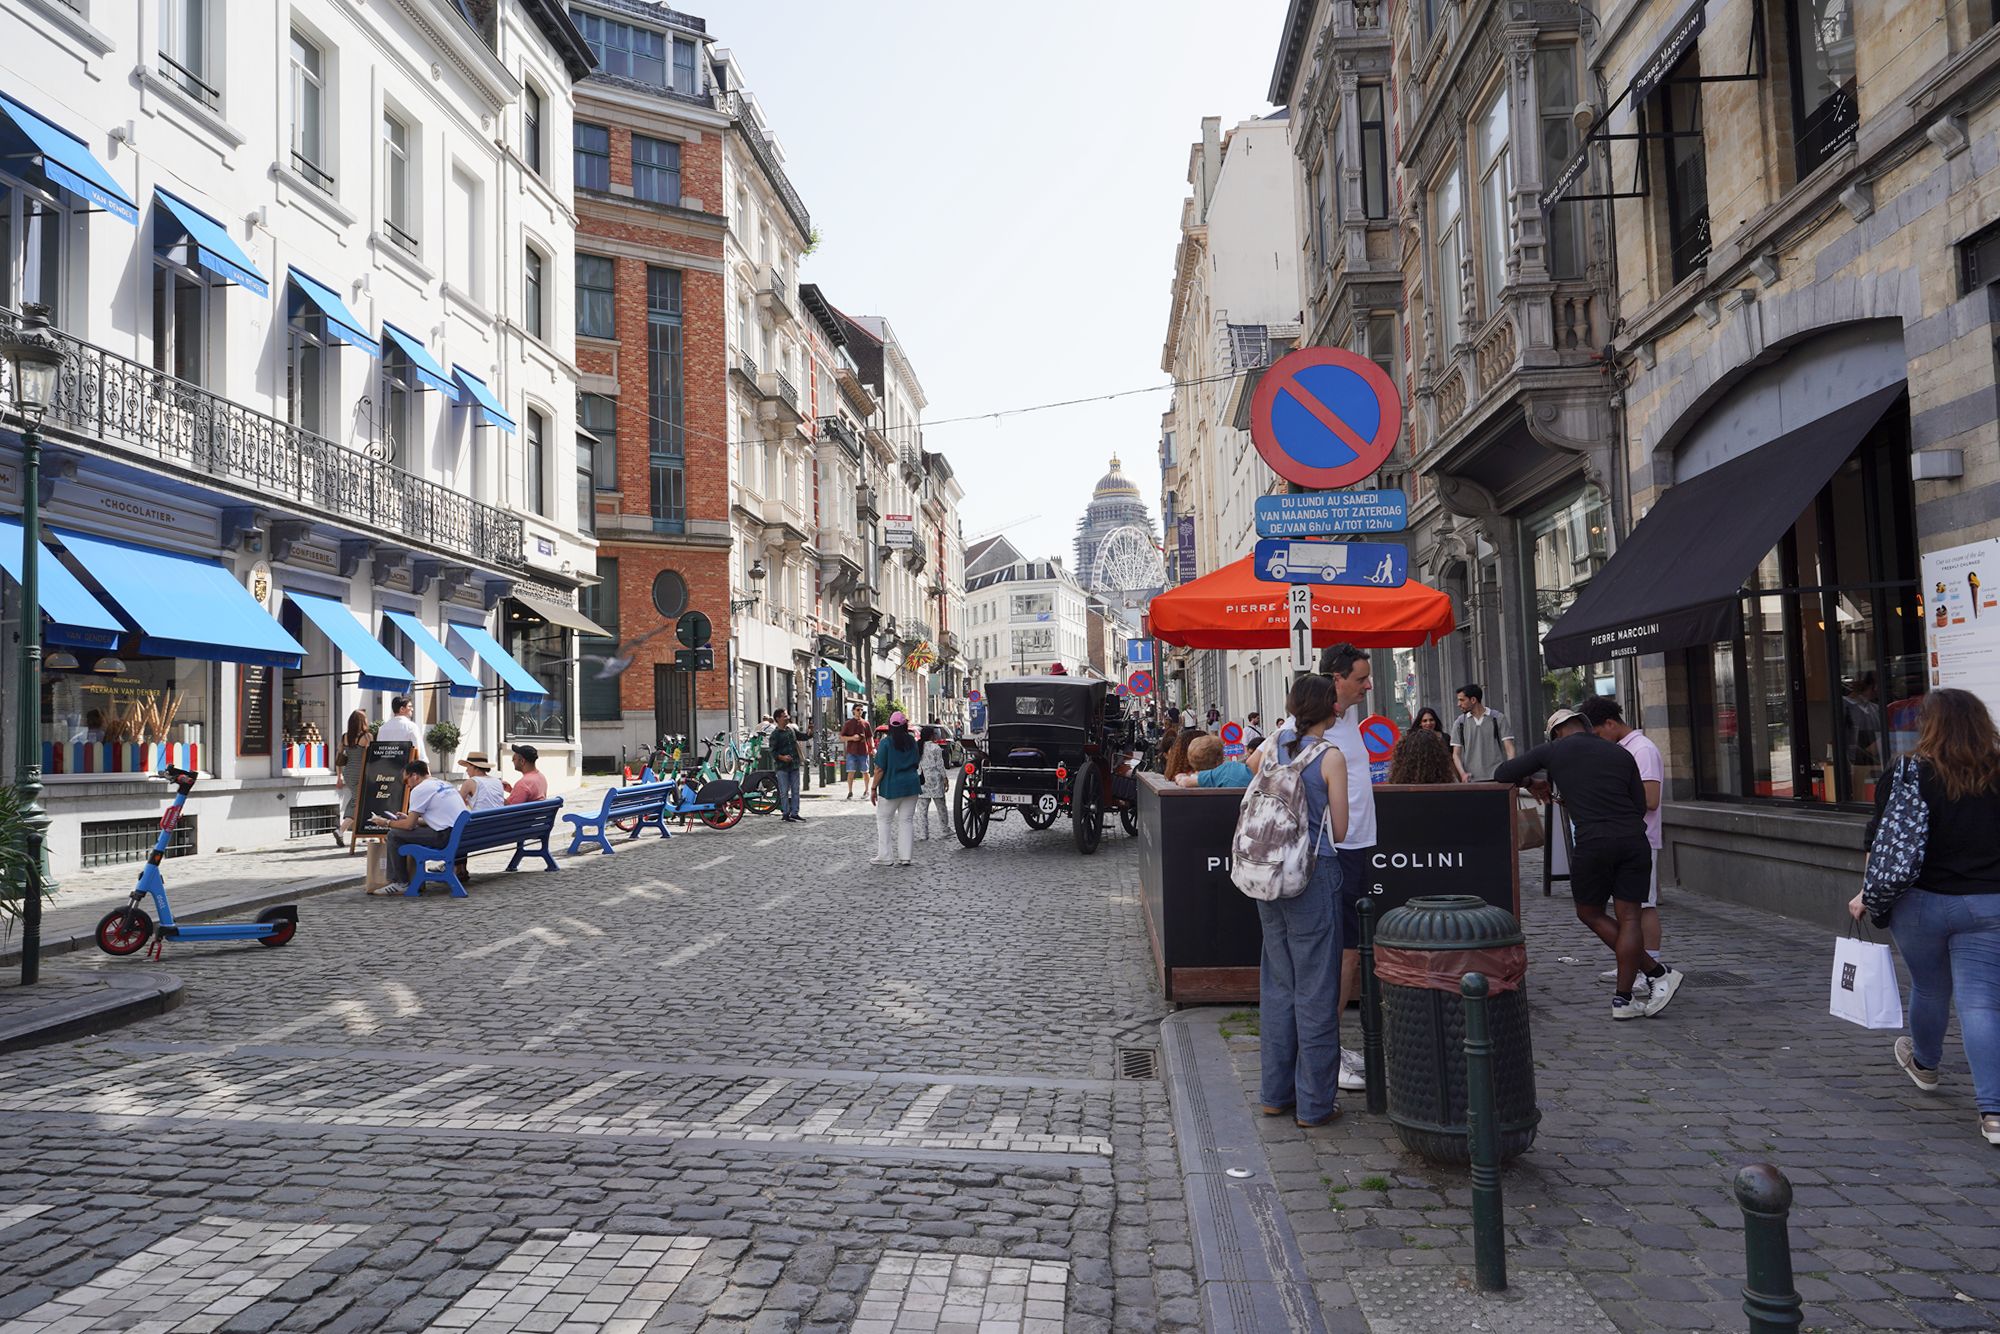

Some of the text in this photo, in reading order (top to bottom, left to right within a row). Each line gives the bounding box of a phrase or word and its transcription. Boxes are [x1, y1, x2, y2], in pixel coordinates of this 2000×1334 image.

[1637, 14, 1699, 92] PIERRE MARCOLINI
[1820, 120, 1859, 154] PIERRE MARCOLI
[1543, 153, 1585, 208] PIERRE MARCOLINI
[91, 191, 107, 205] VAN
[1281, 494, 1379, 508] DU LUNDI AU SAMEDI
[104, 498, 172, 523] CHOCOLATIER
[1260, 505, 1402, 521] VAN MAANDAG TOT ZATERDAG
[1270, 519, 1393, 534] DE/VAN 6h/u A/TOT 12h/u
[1292, 590, 1306, 602] 12
[1226, 603, 1361, 615] PIERRE MCOLINI
[1294, 605, 1306, 613] m
[1591, 623, 1660, 647] PIERRE MARCOLINI
[1611, 646, 1638, 657] BRUSSELS
[818, 671, 829, 687] P
[90, 687, 120, 695] HERMAN
[375, 774, 395, 782] Bean
[1042, 797, 1054, 810] 25
[1371, 853, 1464, 869] COLINI
